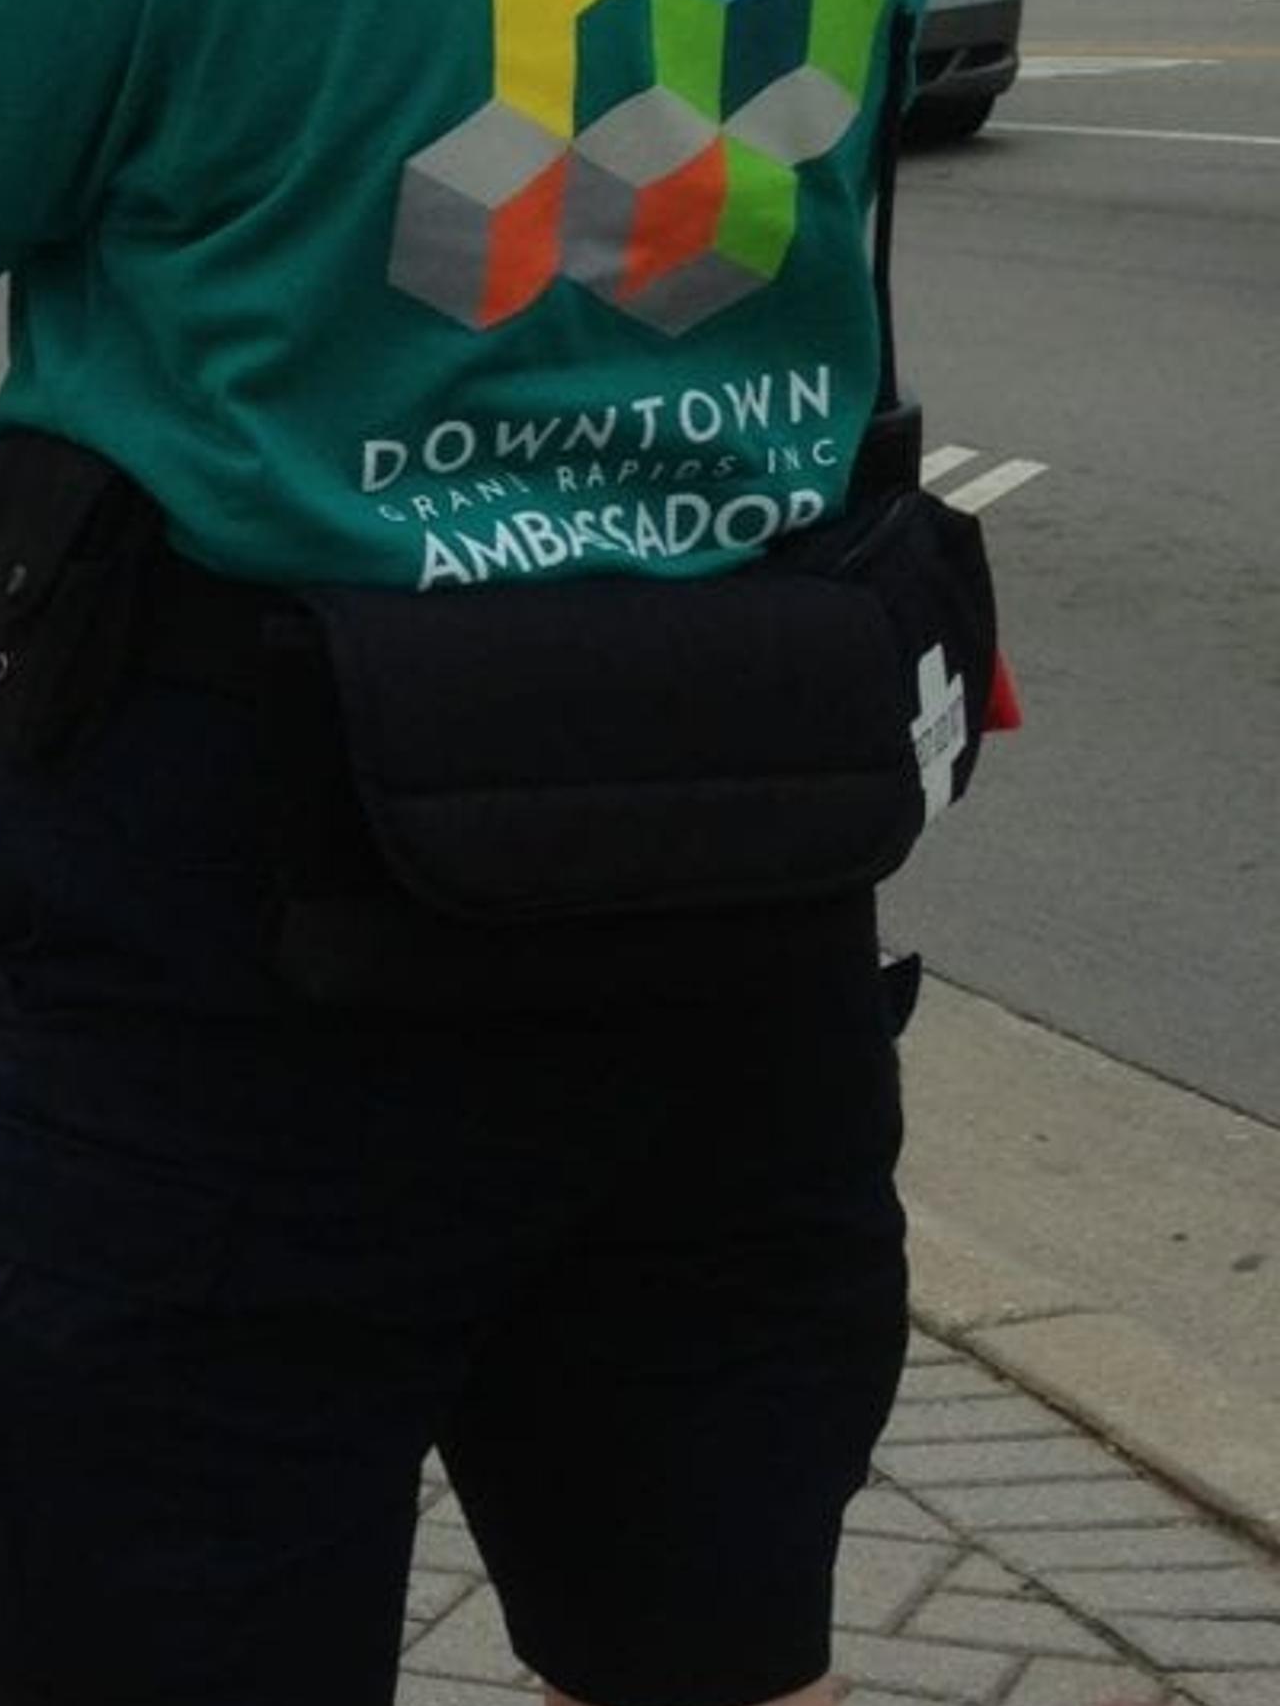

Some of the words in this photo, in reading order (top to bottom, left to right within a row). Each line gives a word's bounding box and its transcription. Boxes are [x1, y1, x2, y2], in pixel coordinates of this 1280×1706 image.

[361, 365, 831, 492] DOWNTOWN
[556, 454, 739, 493] RAPIDS
[767, 438, 838, 474] INC
